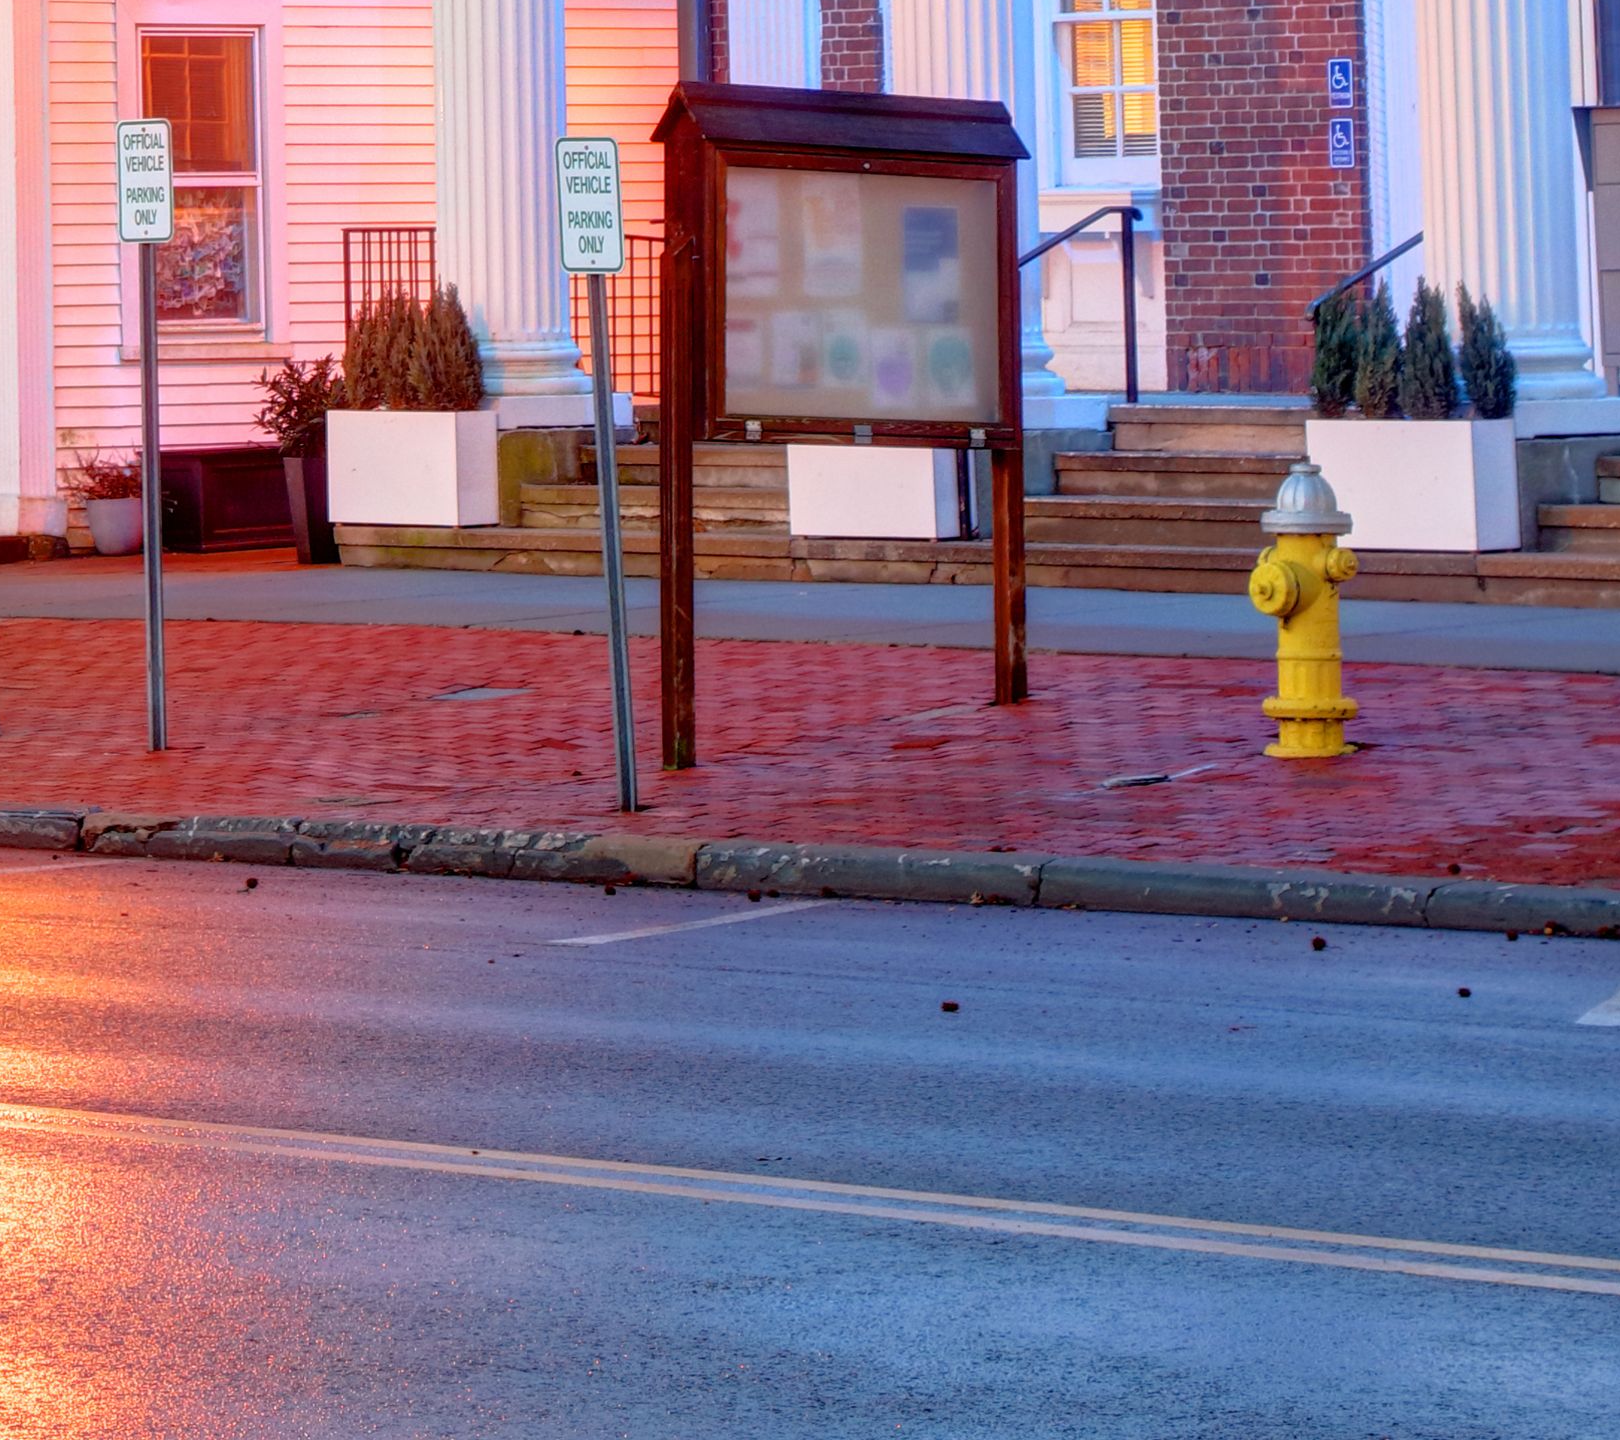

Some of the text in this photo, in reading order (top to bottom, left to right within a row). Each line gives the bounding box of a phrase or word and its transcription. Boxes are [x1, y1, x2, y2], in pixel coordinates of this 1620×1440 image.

[123, 133, 165, 151] OFFICIAL
[125, 155, 165, 172] VEHICLE
[563, 151, 612, 170] OFFICIAL
[565, 176, 612, 194] VEHICLE
[126, 186, 165, 204] PARKING
[134, 209, 157, 226] ONLY
[567, 211, 613, 229] PARKING
[578, 235, 605, 254] ONLY
